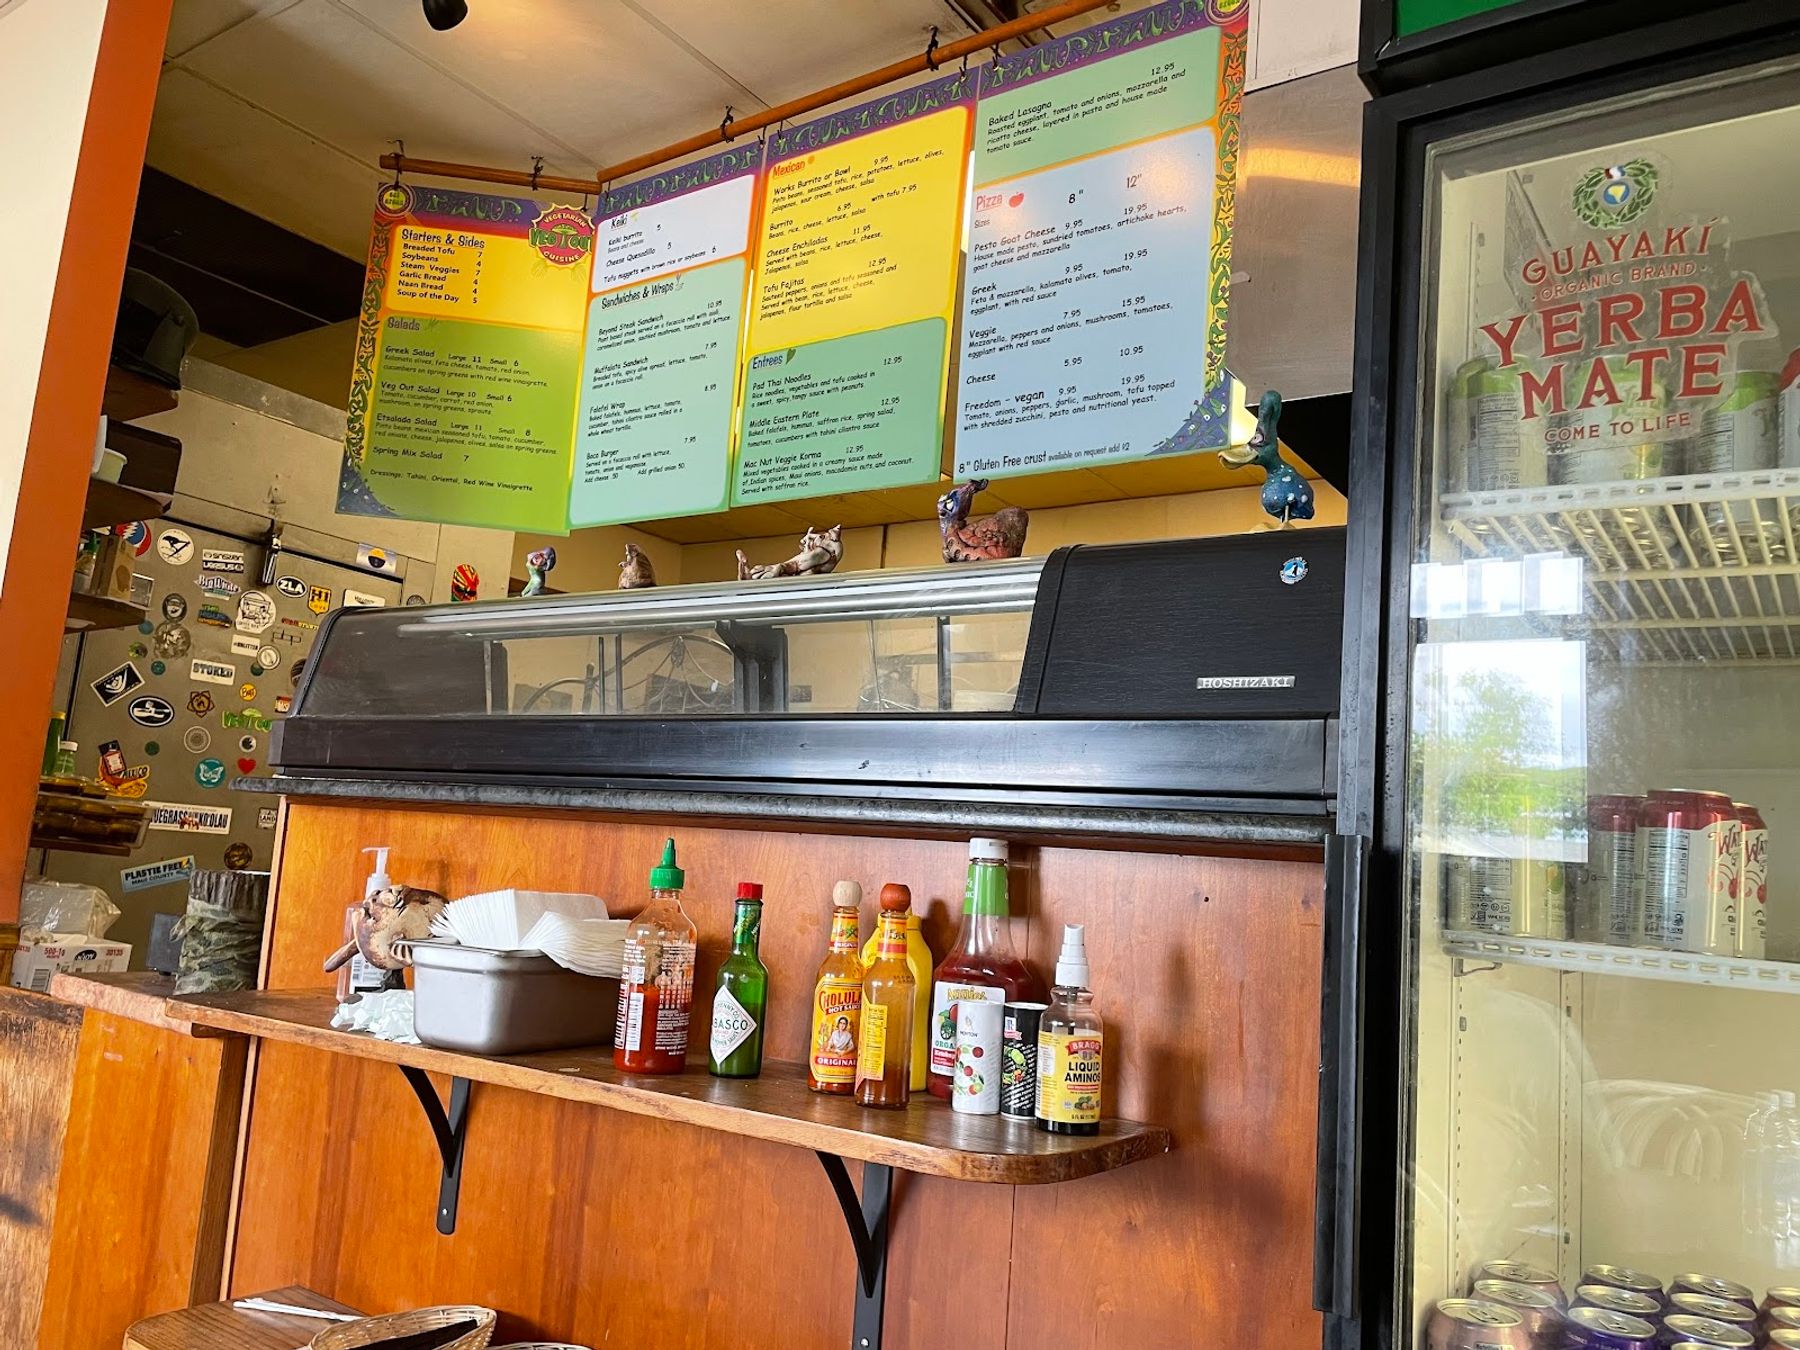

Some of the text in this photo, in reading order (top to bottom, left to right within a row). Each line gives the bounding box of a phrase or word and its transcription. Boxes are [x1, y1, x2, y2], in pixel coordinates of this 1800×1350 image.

[987, 121, 1016, 135] Roasted
[1052, 103, 1078, 115] tomato
[1080, 96, 1095, 107] and
[1126, 75, 1168, 93] mozzarella
[1171, 68, 1186, 80] and
[988, 62, 1175, 126] Baked Lasagna 12.95
[773, 161, 806, 176] Mexican
[774, 184, 795, 195] Works
[797, 176, 822, 189] Burrito
[823, 173, 833, 181] or
[834, 165, 851, 177] Bowl
[976, 194, 1003, 210] Pizza
[543, 212, 588, 228] VEGETARIAN
[769, 219, 793, 231] Burrito
[871, 194, 885, 202] with
[974, 203, 1148, 253] Pesto Goat Cheese 9.95 19.95
[401, 228, 485, 249] Starters & Sides
[766, 247, 790, 258] Cheese
[792, 236, 828, 251] Enchiladas
[402, 252, 439, 262] Soybeans
[403, 243, 436, 252] Breaded
[437, 246, 455, 255] Tofu
[543, 250, 581, 264] CUISINE
[400, 261, 425, 270] Steam
[429, 264, 460, 275] Veggies
[606, 257, 625, 268] Cheese
[399, 270, 421, 279] Garlic
[423, 273, 447, 282] Bread
[971, 248, 1148, 296] Greek 9.95 19.95
[398, 279, 419, 288] Naan
[420, 282, 444, 291] Bread
[763, 283, 779, 293] Tofu
[780, 278, 805, 290] Fajitas
[1541, 261, 1698, 302] ORGANIC BRAND
[397, 288, 417, 298] Soup
[429, 292, 443, 300] the
[444, 293, 459, 304] Day
[472, 296, 478, 304] 5
[601, 282, 674, 310] Sandwiches & Wraps
[387, 316, 420, 331] Salads
[969, 295, 1146, 339] Veggie 7.95 15.95
[1479, 280, 1765, 368] YERBA
[752, 355, 783, 370] Entrees
[966, 345, 1144, 385] Cheese 5.95 10.95
[752, 355, 903, 391] Pad Thai Noodles 12.95
[1516, 344, 1729, 421] MATE
[965, 399, 1002, 411] Freedom
[1014, 391, 1045, 404] vegan
[1058, 385, 1077, 396] 9.95
[1121, 373, 1145, 385] 19.95
[749, 396, 900, 428] Middle Eastern Plate 12.95
[1544, 412, 1692, 444] COME TO LIFE
[372, 446, 470, 462] Spring Mix Salad 7
[743, 461, 758, 469] Mac
[759, 458, 773, 467] Nut
[775, 455, 797, 465] Veggie
[799, 452, 822, 460] Korma
[973, 458, 1000, 472] Gluten
[1003, 455, 1022, 467] Free
[1023, 450, 1047, 465] crust
[1074, 450, 1083, 458] on
[1108, 443, 1121, 453] add
[193, 662, 233, 679] STOKED
[1203, 677, 1291, 688] HOSHIZAKI
[844, 1003, 862, 1012] SAUC
[1072, 1040, 1100, 1050] BRAGG
[1068, 1061, 1100, 1073] LIQUID
